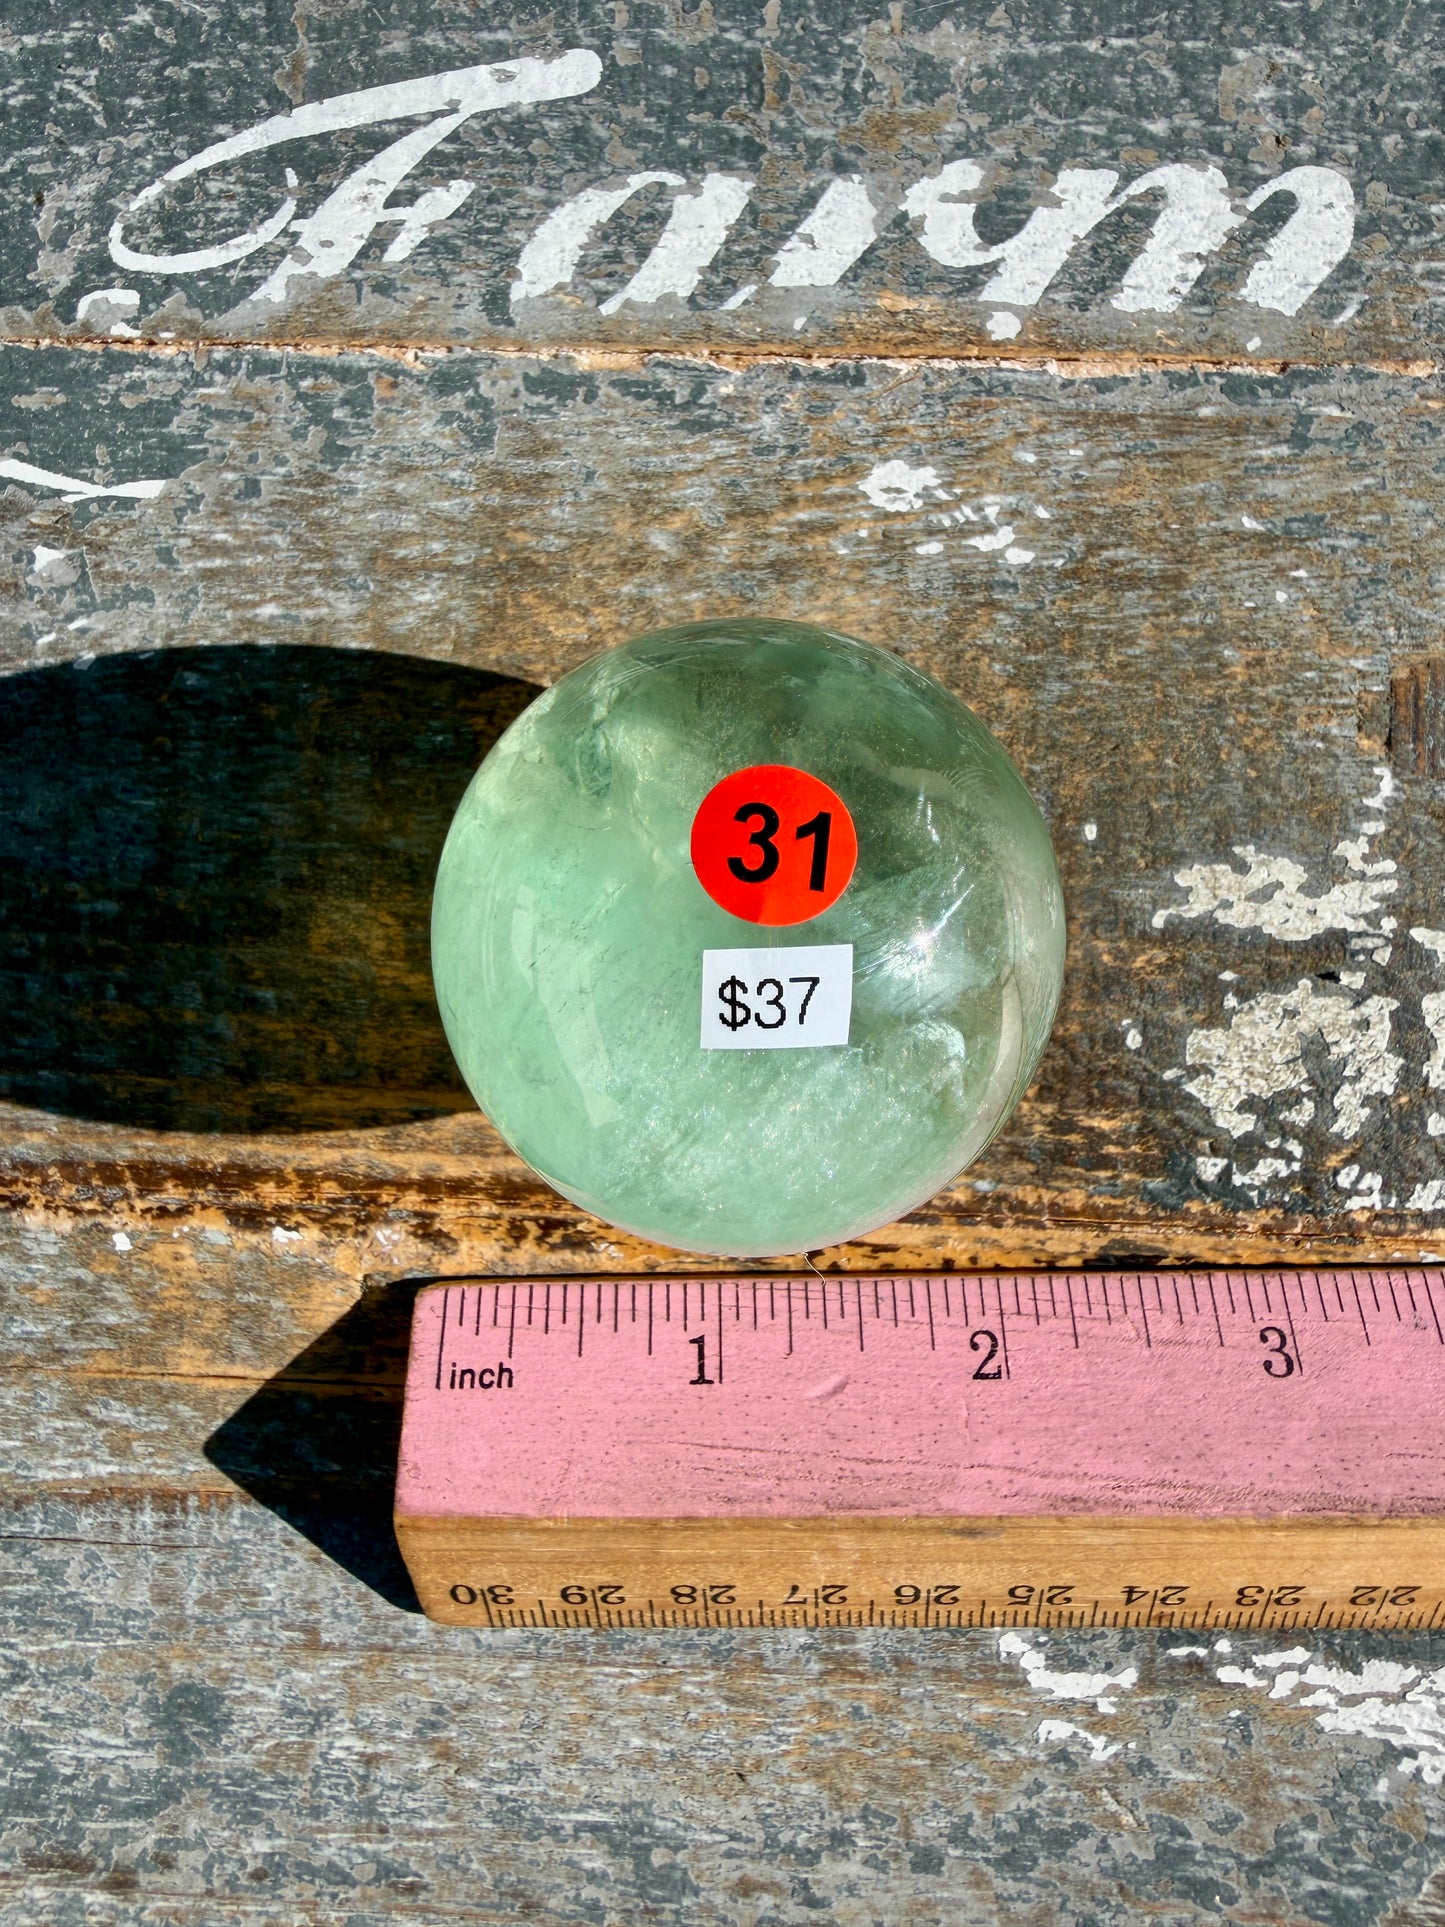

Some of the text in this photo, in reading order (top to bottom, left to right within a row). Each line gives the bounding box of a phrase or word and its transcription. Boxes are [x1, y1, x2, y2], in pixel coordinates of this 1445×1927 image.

[727, 802, 832, 893] 31
[719, 976, 820, 1031] $37
[449, 1326, 1295, 1390] inch 1 2 3
[450, 1585, 1422, 1606] 22 23 24 25 26 27 28 29 30
